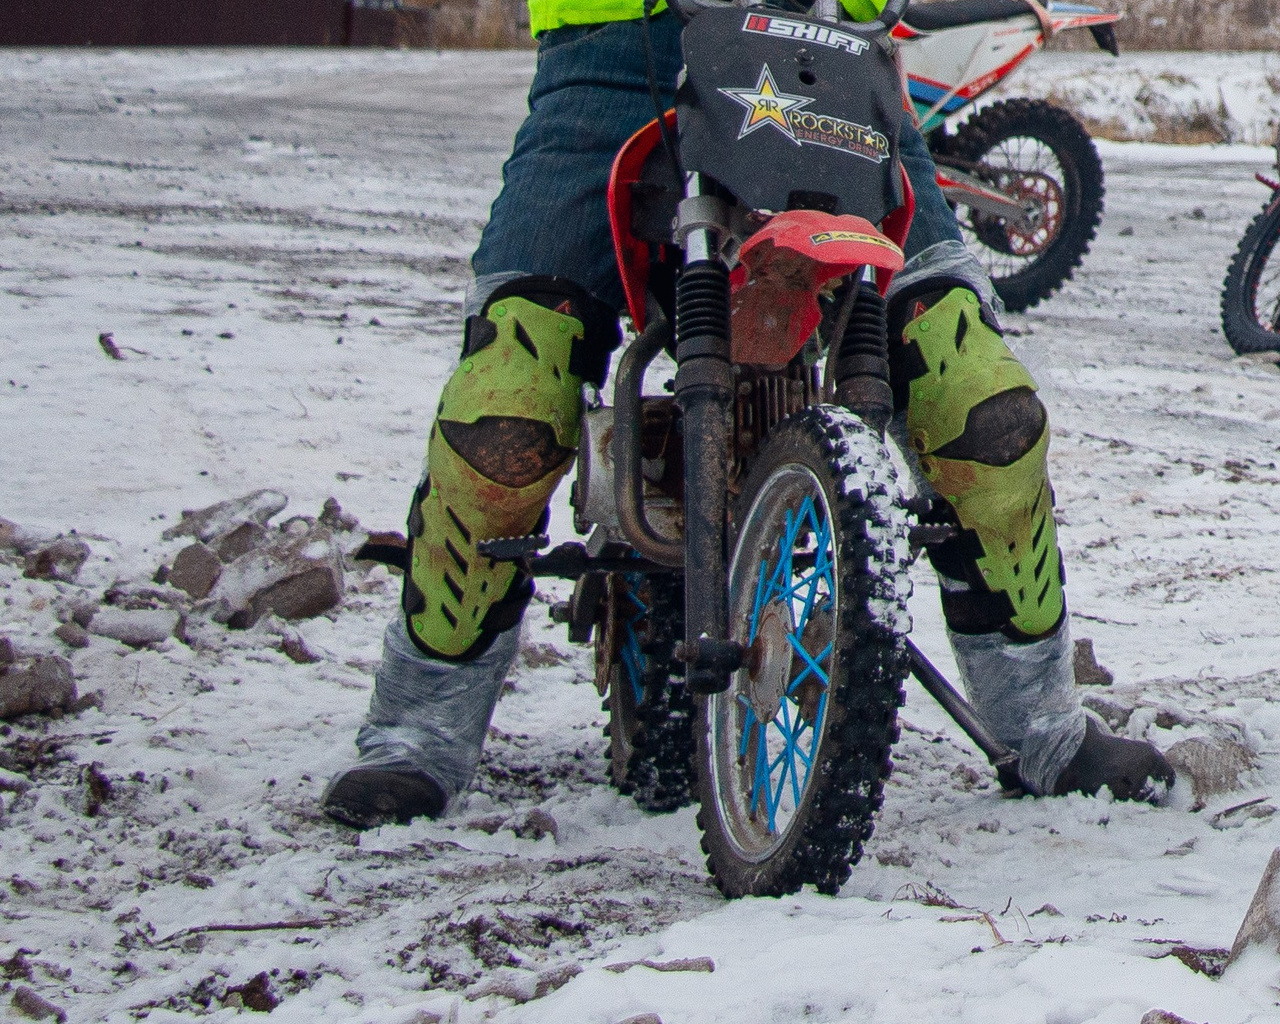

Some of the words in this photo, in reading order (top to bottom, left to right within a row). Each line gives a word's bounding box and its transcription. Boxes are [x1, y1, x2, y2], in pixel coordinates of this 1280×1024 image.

[767, 18, 868, 53] SHIFT
[796, 128, 843, 147] ENERGY
[848, 140, 880, 158] DRINK
